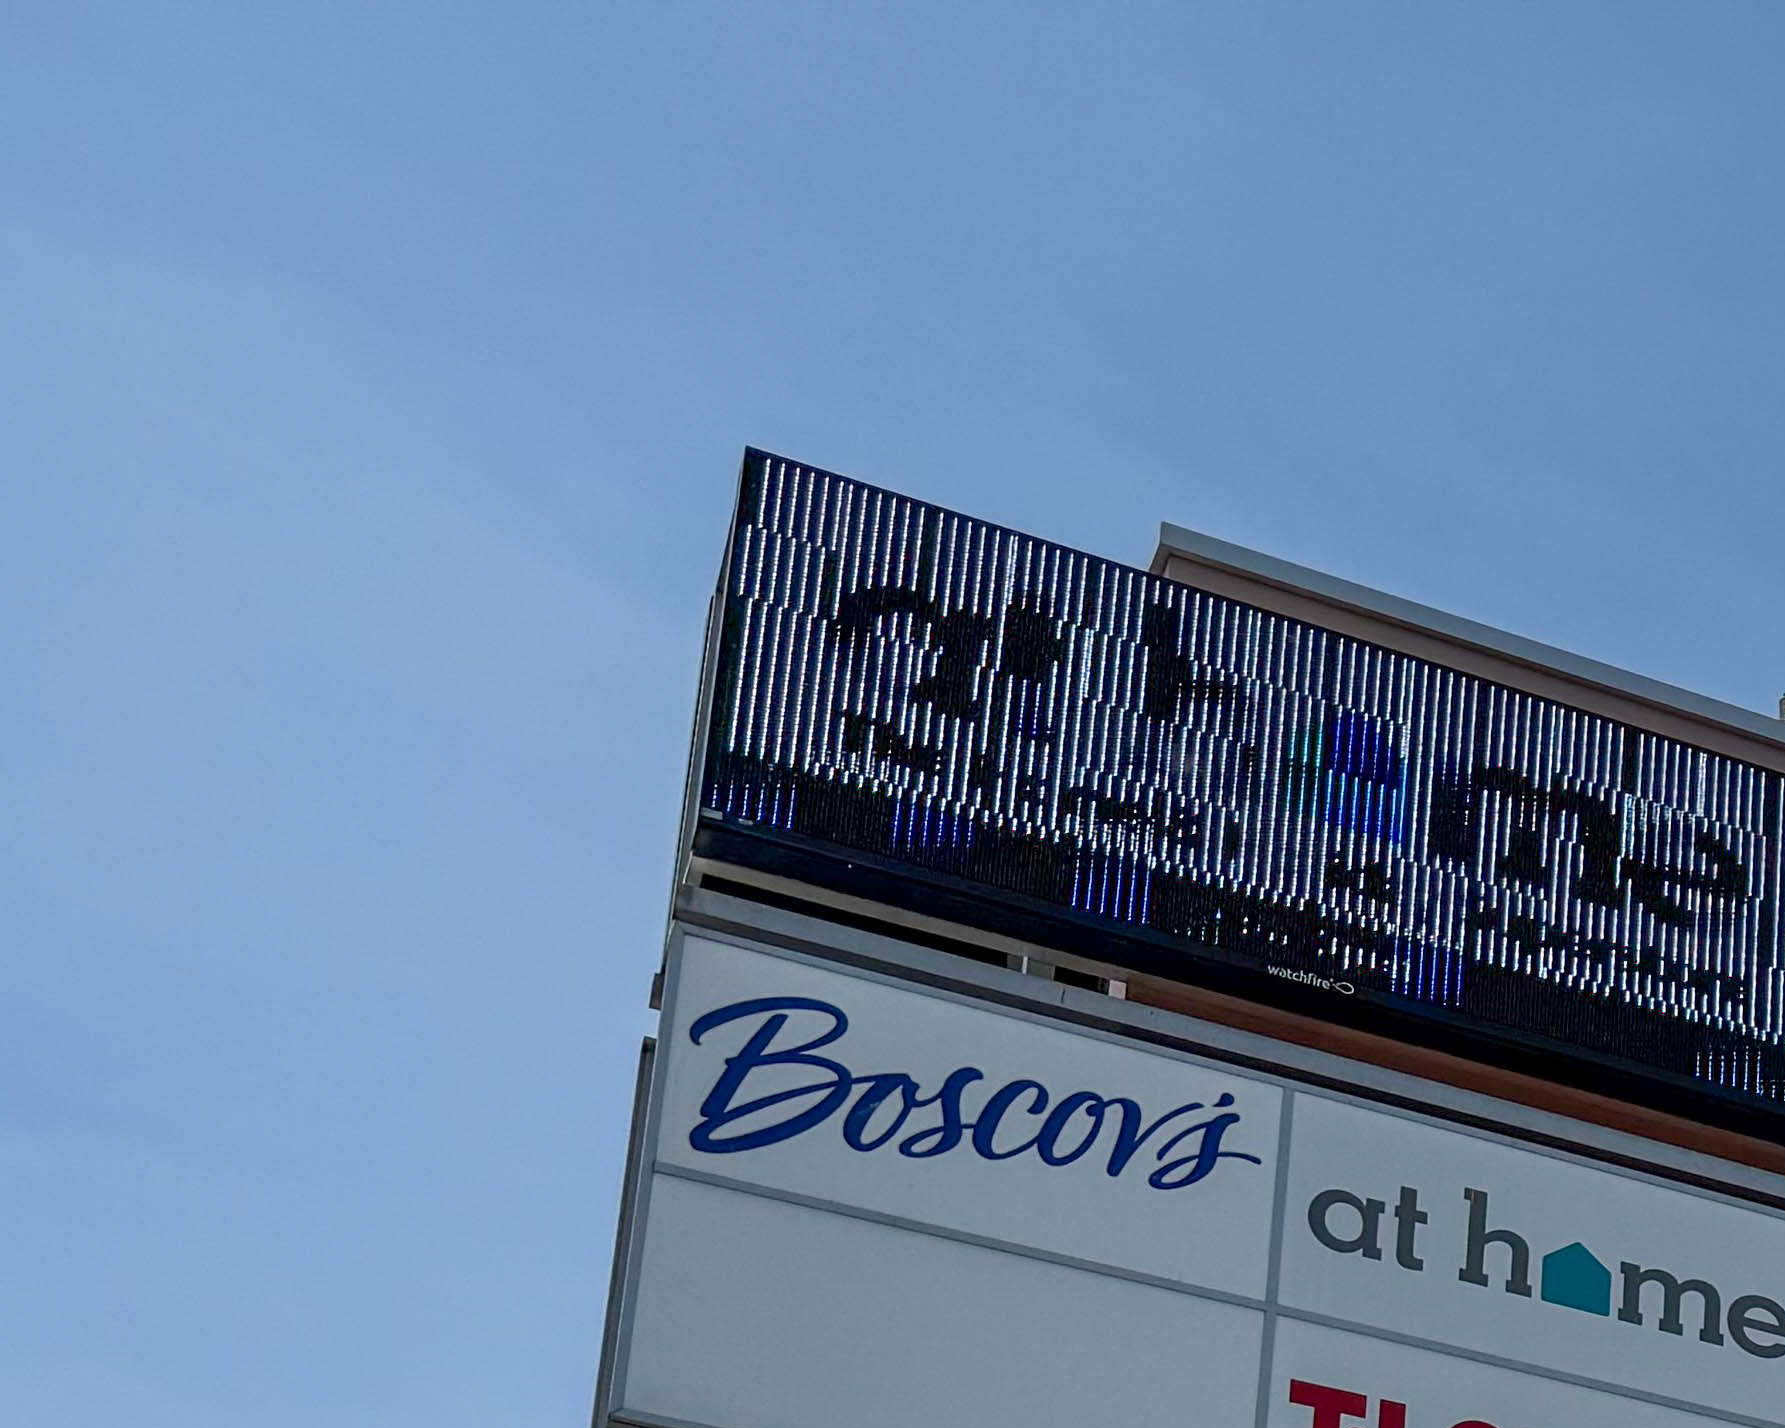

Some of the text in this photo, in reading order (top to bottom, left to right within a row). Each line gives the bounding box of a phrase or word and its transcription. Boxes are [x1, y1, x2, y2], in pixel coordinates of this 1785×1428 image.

[1267, 964, 1332, 990] watchfire
[688, 996, 1262, 1190] Boscov's
[1307, 1185, 1425, 1274] at
